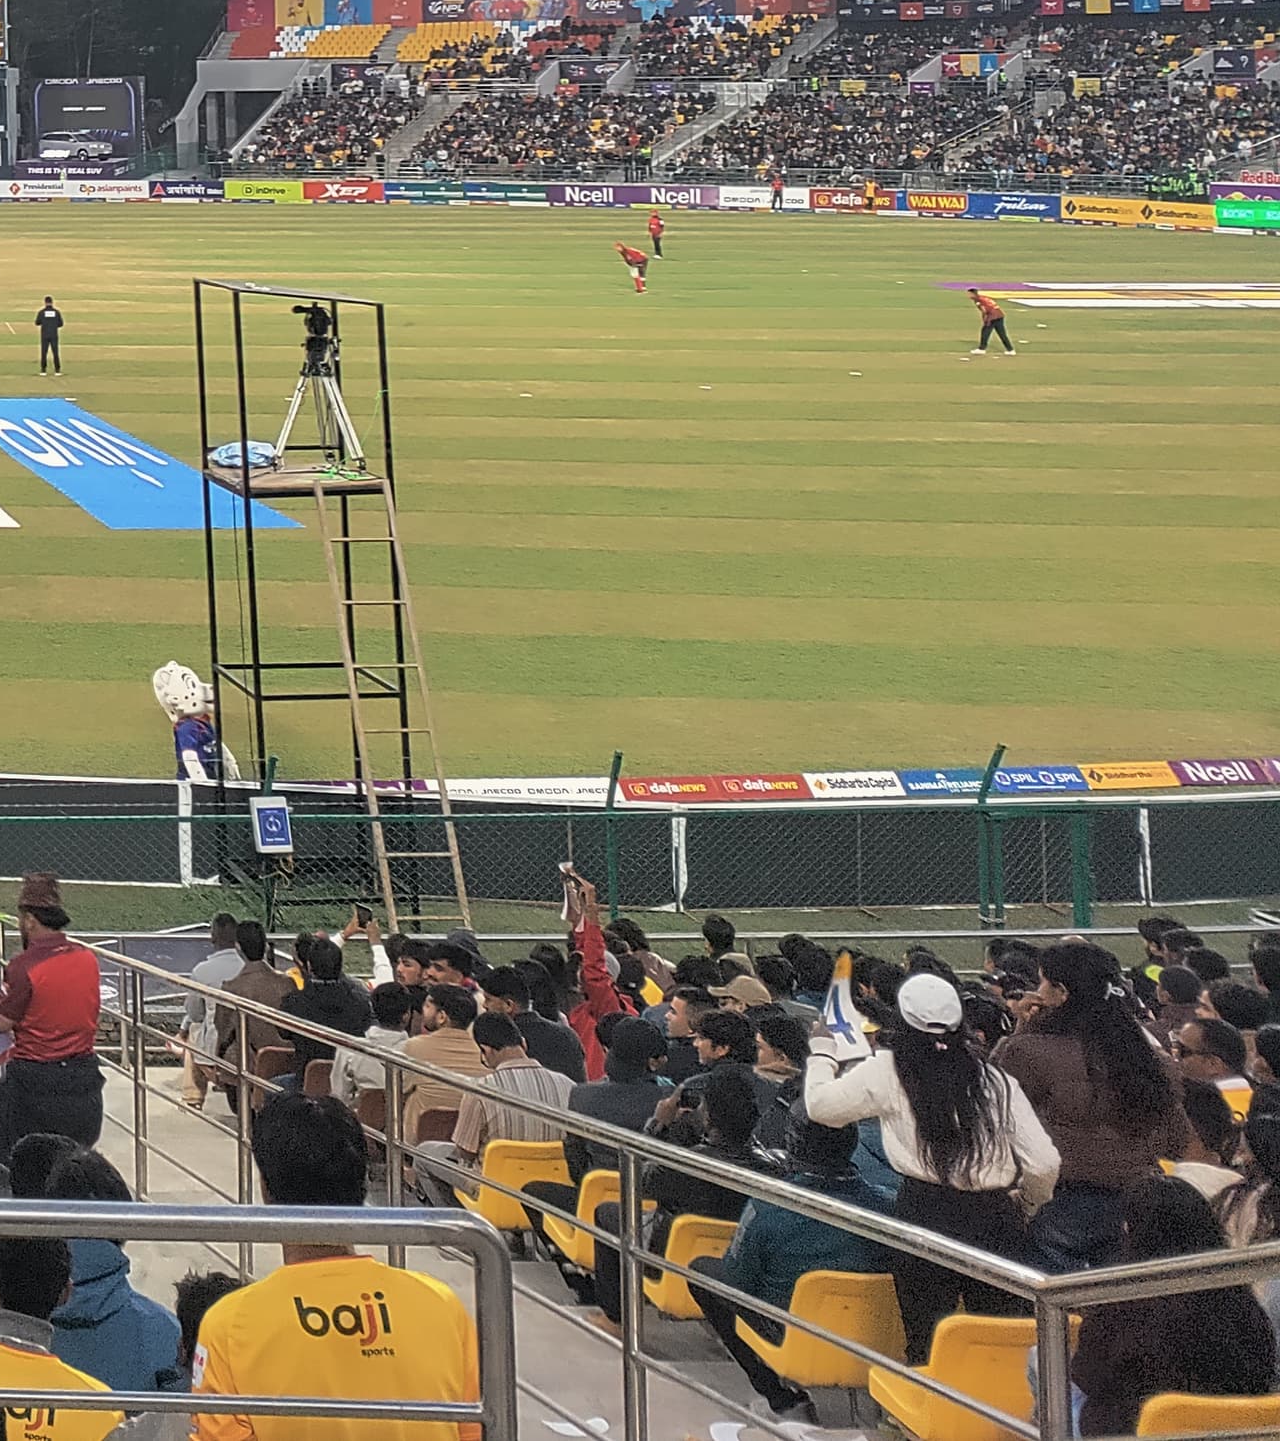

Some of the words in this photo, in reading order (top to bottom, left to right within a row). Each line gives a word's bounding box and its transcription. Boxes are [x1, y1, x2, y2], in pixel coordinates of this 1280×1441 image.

[28, 167, 44, 175] THIS
[68, 167, 85, 175] REAL
[86, 167, 102, 175] SUV
[1241, 171, 1262, 184] Red
[23, 183, 64, 191] Presidential
[97, 184, 143, 194] asianpaints
[255, 185, 286, 195] inDrive
[565, 186, 614, 203] Ncell
[651, 187, 701, 204] Ncell
[910, 195, 937, 208] WAI
[939, 196, 965, 209] WAI
[1012, 772, 1037, 783] SPIL
[1057, 772, 1082, 783] SPIL
[1182, 761, 1256, 783] Ncell
[293, 1290, 392, 1346] baji
[361, 1346, 395, 1357] sports
